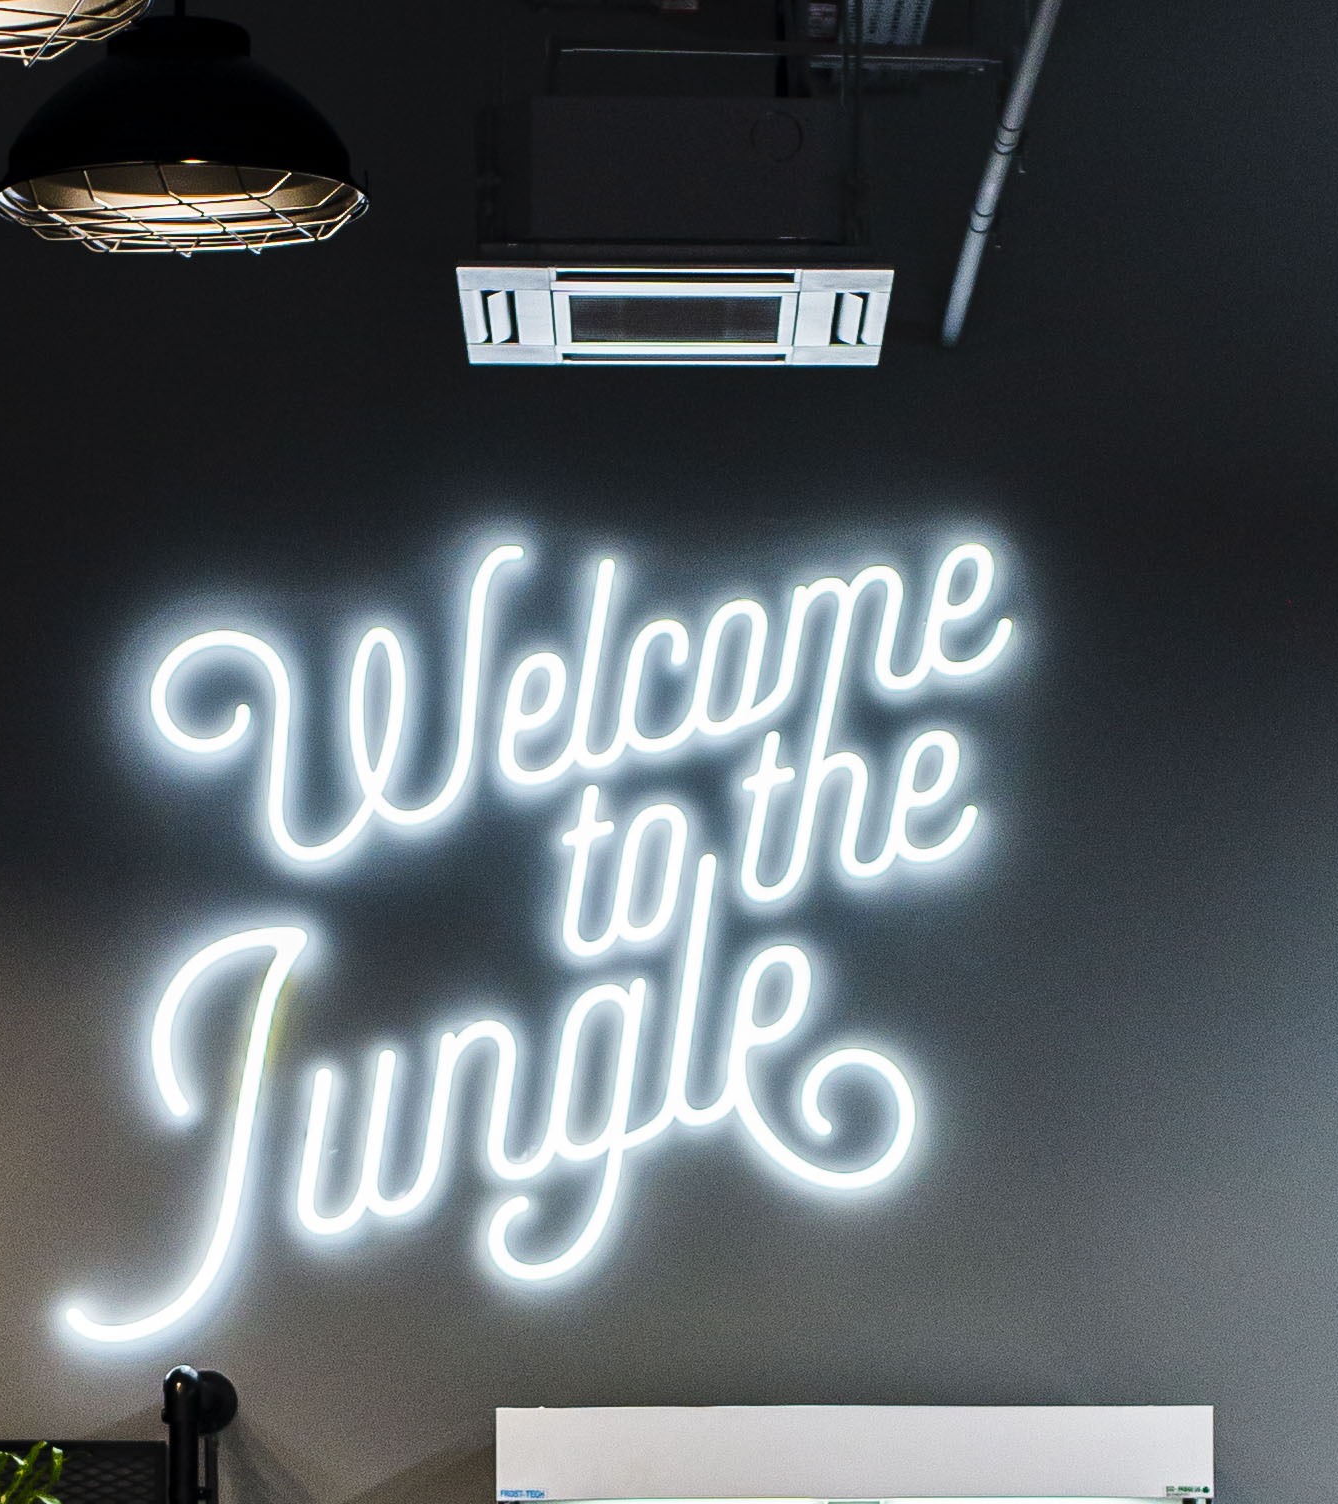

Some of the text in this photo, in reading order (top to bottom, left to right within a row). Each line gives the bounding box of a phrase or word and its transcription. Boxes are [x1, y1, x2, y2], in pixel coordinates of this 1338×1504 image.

[148, 541, 1014, 863] Welcome
[560, 714, 979, 958] to the
[65, 853, 917, 1342] Jungle
